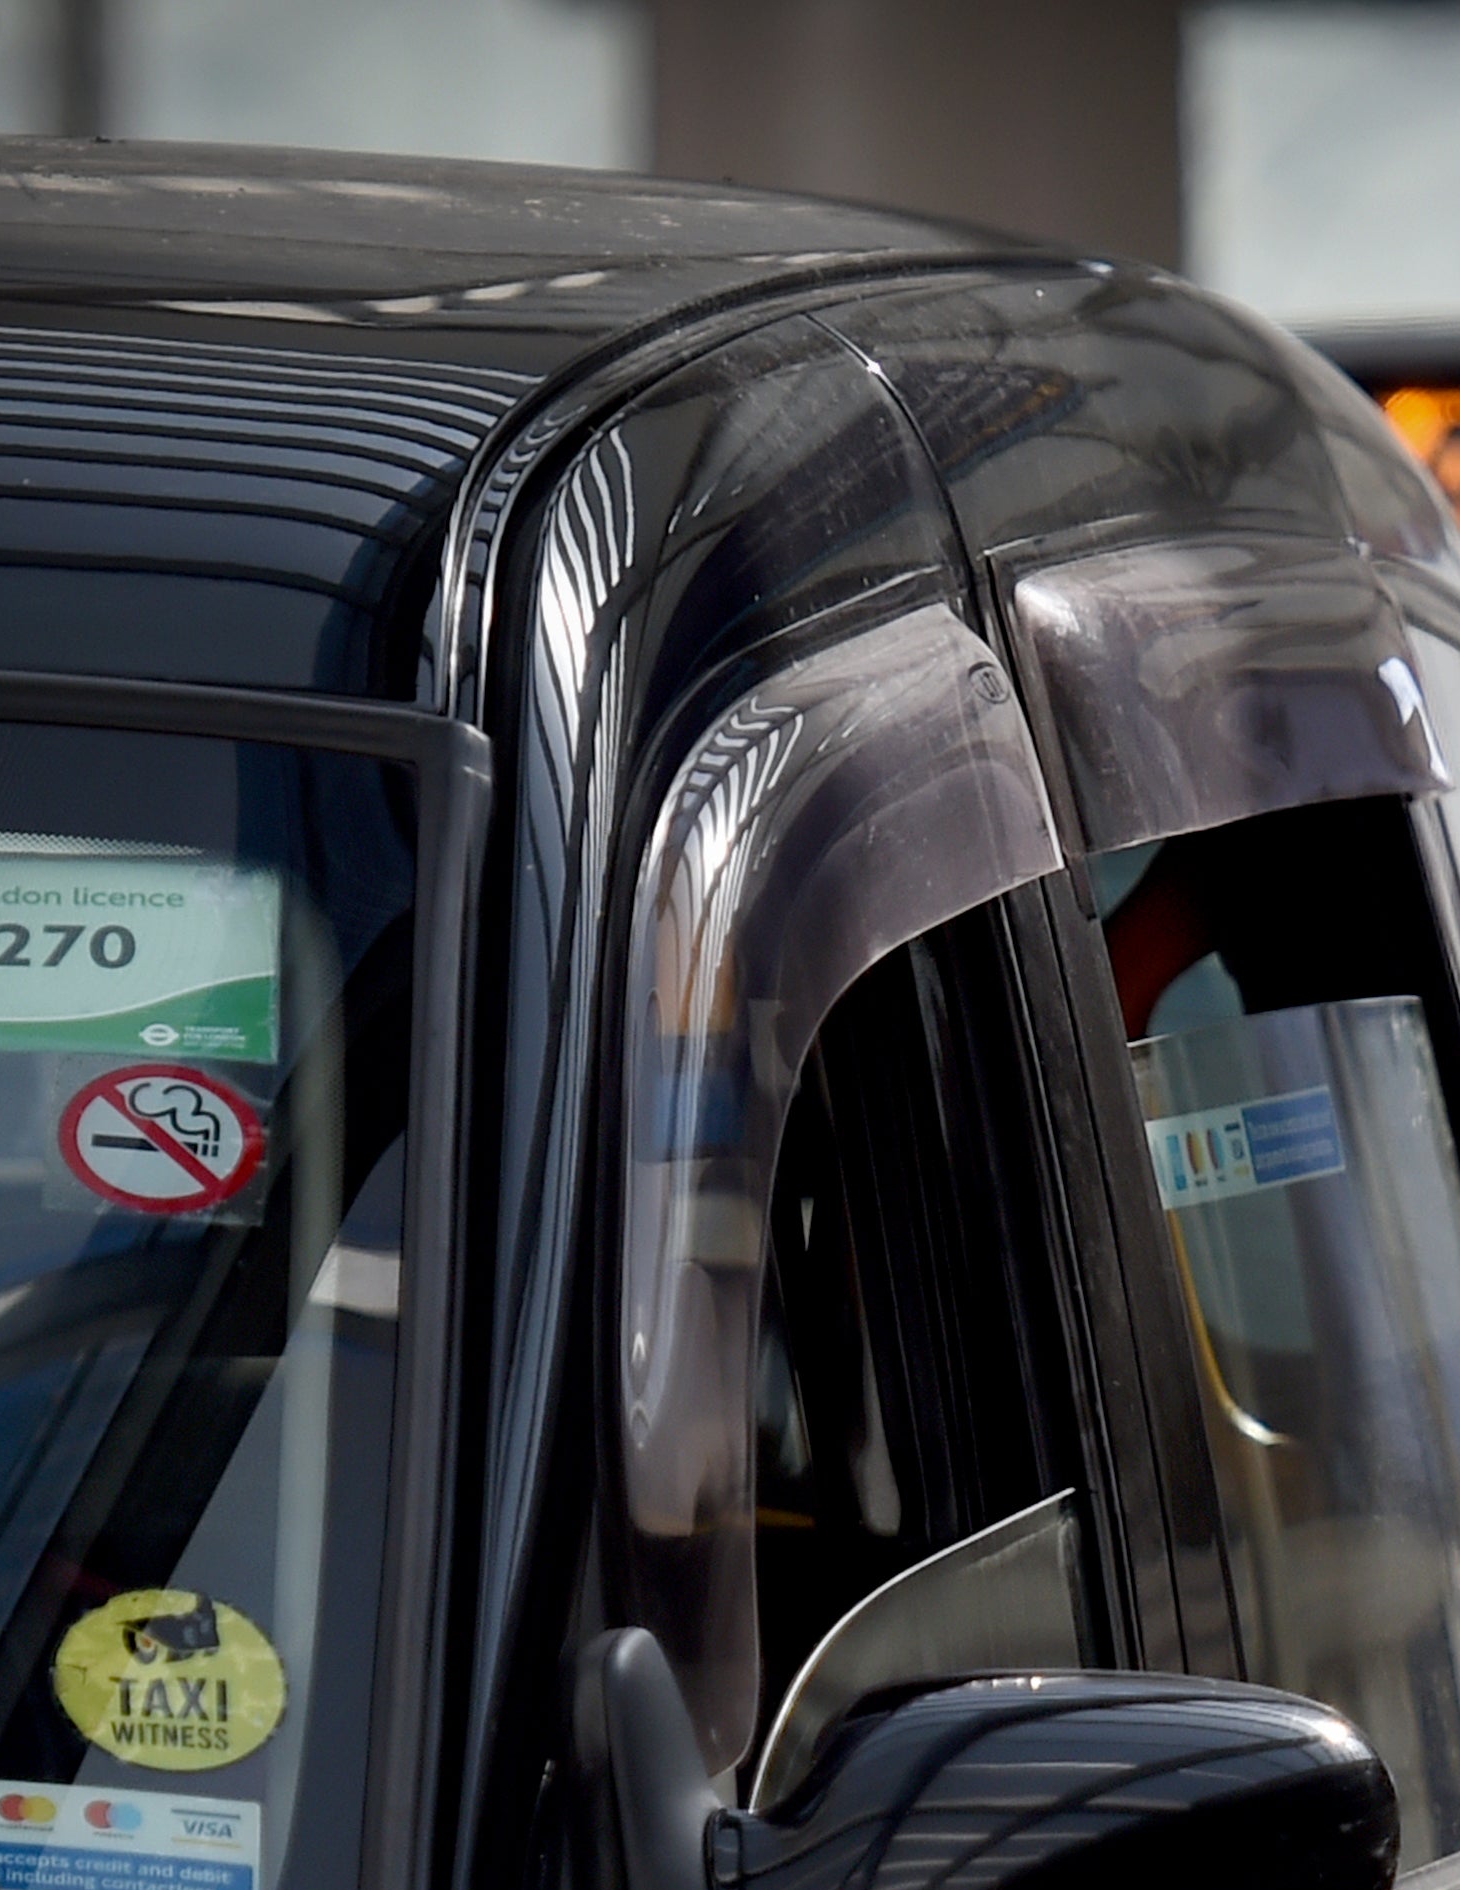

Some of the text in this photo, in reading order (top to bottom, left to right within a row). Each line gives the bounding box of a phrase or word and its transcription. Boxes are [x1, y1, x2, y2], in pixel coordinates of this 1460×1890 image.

[73, 887, 185, 908] licence
[108, 1675, 228, 1723] TAXI
[111, 1721, 230, 1750] WITNESS
[182, 1818, 233, 1839] VISA
[6, 1869, 95, 1890] including
[75, 1857, 132, 1875] credit
[138, 1864, 174, 1879] and
[180, 1867, 232, 1885] debit
